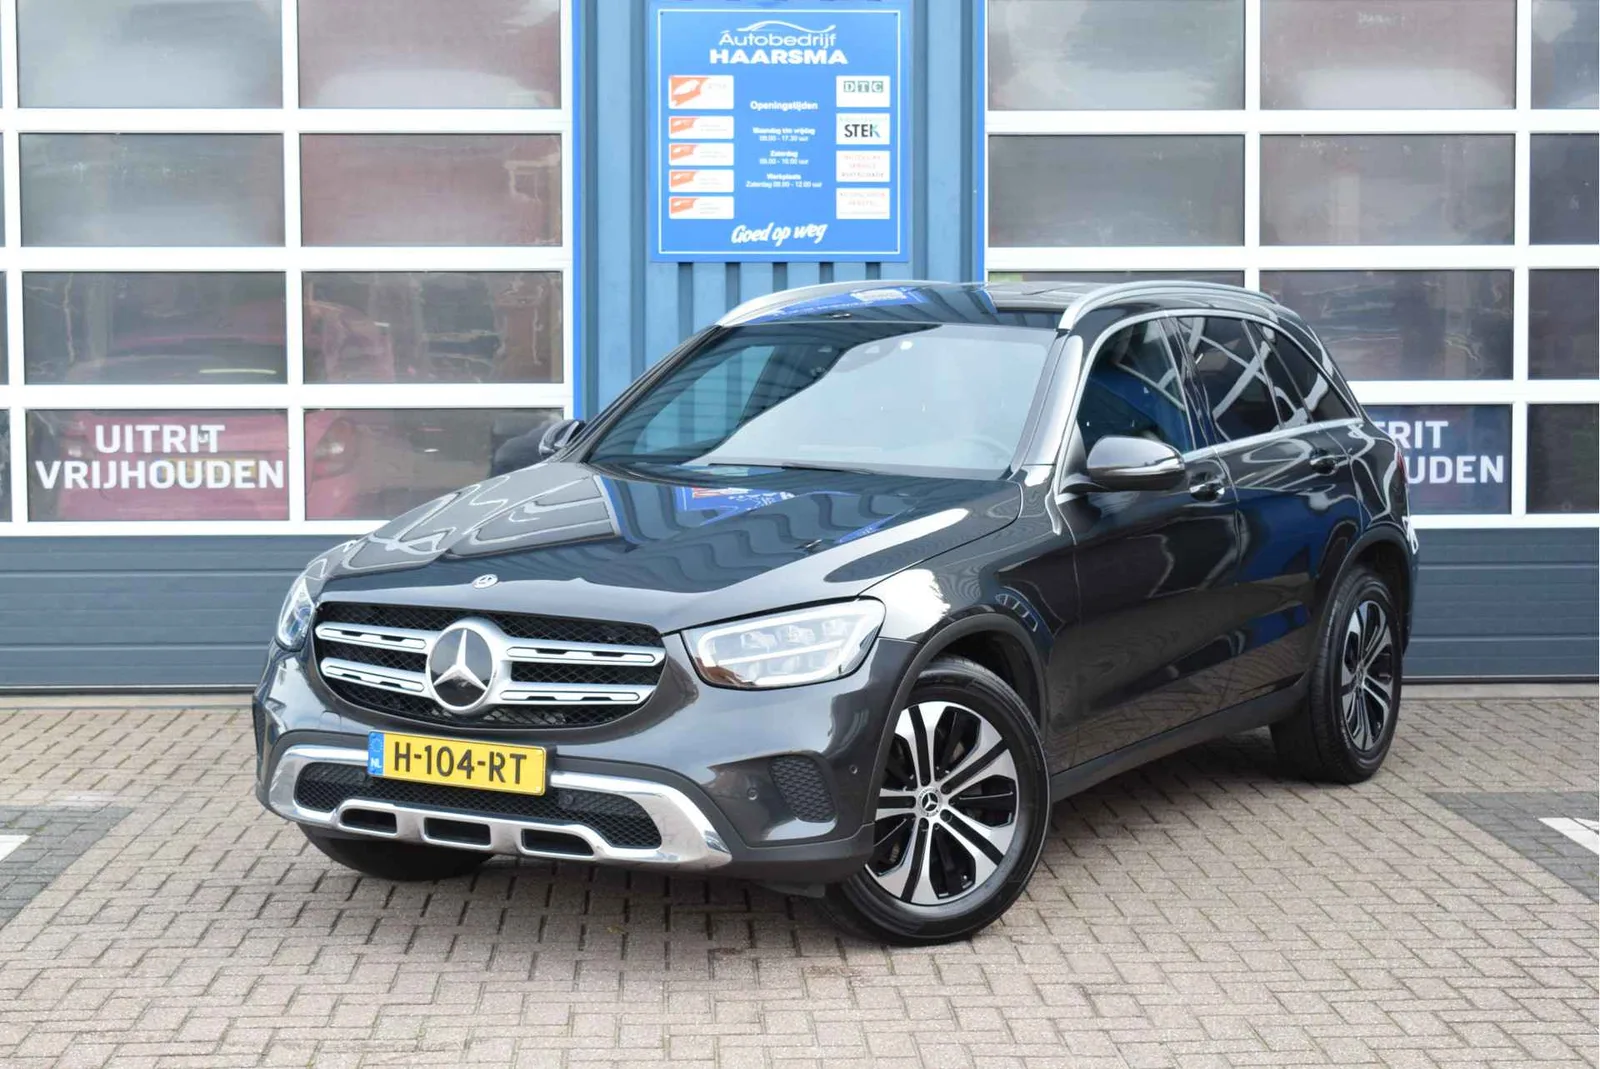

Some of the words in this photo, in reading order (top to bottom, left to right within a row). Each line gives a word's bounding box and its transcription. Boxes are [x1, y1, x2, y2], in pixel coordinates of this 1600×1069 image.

[718, 32, 837, 49] Autobedrijf
[709, 49, 848, 65] HAARSMA
[843, 80, 884, 93] DTC
[750, 101, 818, 112] Openingstijden
[844, 123, 881, 138] STEK
[730, 222, 775, 244] Goed
[772, 228, 791, 247] op
[793, 223, 828, 244] weg
[95, 424, 226, 454] UITRIT
[35, 460, 284, 490] VRIJHOUDEN
[1404, 455, 1504, 485] UDEN
[370, 757, 383, 769] NL
[393, 741, 528, 785] H-104-RT
